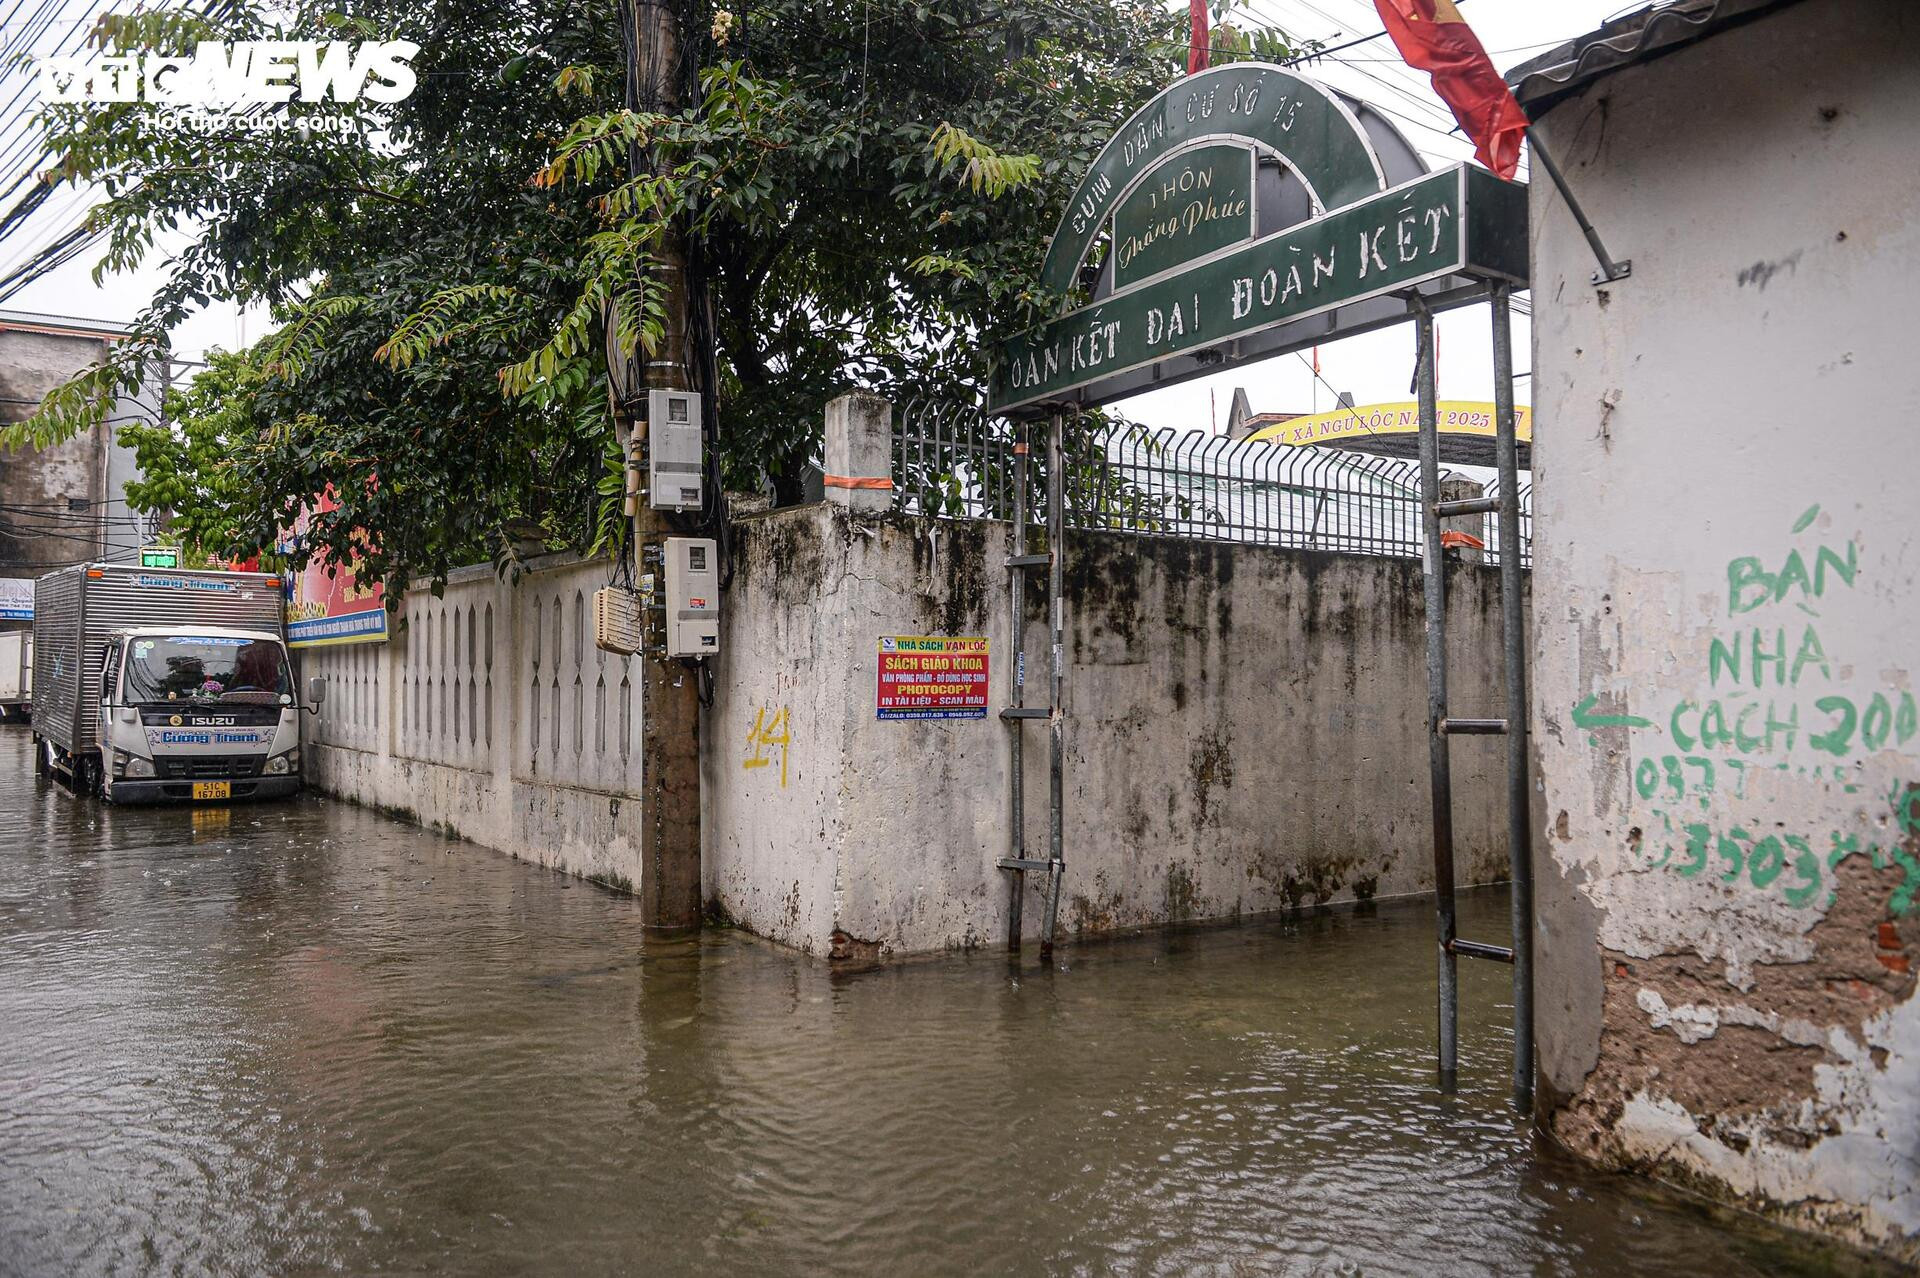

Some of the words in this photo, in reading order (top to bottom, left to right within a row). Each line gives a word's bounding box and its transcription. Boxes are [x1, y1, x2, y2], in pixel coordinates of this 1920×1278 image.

[1123, 115, 1164, 168] DÂN
[1273, 95, 1304, 132] 15
[1149, 165, 1213, 209] THÔN
[1182, 189, 1246, 236] Phúc
[1071, 308, 1121, 372] KẾT
[1231, 244, 1336, 320] ĐOÀN
[1359, 191, 1450, 278] KẾT
[1319, 415, 1356, 435] NGƯ
[1359, 409, 1393, 431] LỘC
[1446, 410, 1490, 428] 2025
[1727, 503, 1857, 619] BÁN
[897, 639, 917, 650] NHÀ
[919, 639, 944, 651] SÁCH
[946, 641, 966, 652] VẠN
[968, 640, 986, 652] LỘC
[1709, 601, 1831, 690] NHÀ
[885, 655, 918, 670] SÁCH
[921, 655, 950, 670] GIÁO
[953, 657, 983, 670] KHOA
[882, 673, 895, 683] VĂN
[896, 672, 915, 683] PHÒNG
[945, 672, 961, 684] DÙNG
[961, 673, 973, 685] HỌC
[973, 673, 986, 683] SINH
[897, 684, 973, 695] PHOTOCOPY
[881, 697, 892, 705] IN
[895, 696, 909, 705] TÀI
[911, 696, 931, 706] LIỆU
[939, 696, 963, 705] SCAN
[965, 695, 984, 705] MÀU
[191, 717, 235, 726] ISUZU
[203, 783, 220, 791] 51C
